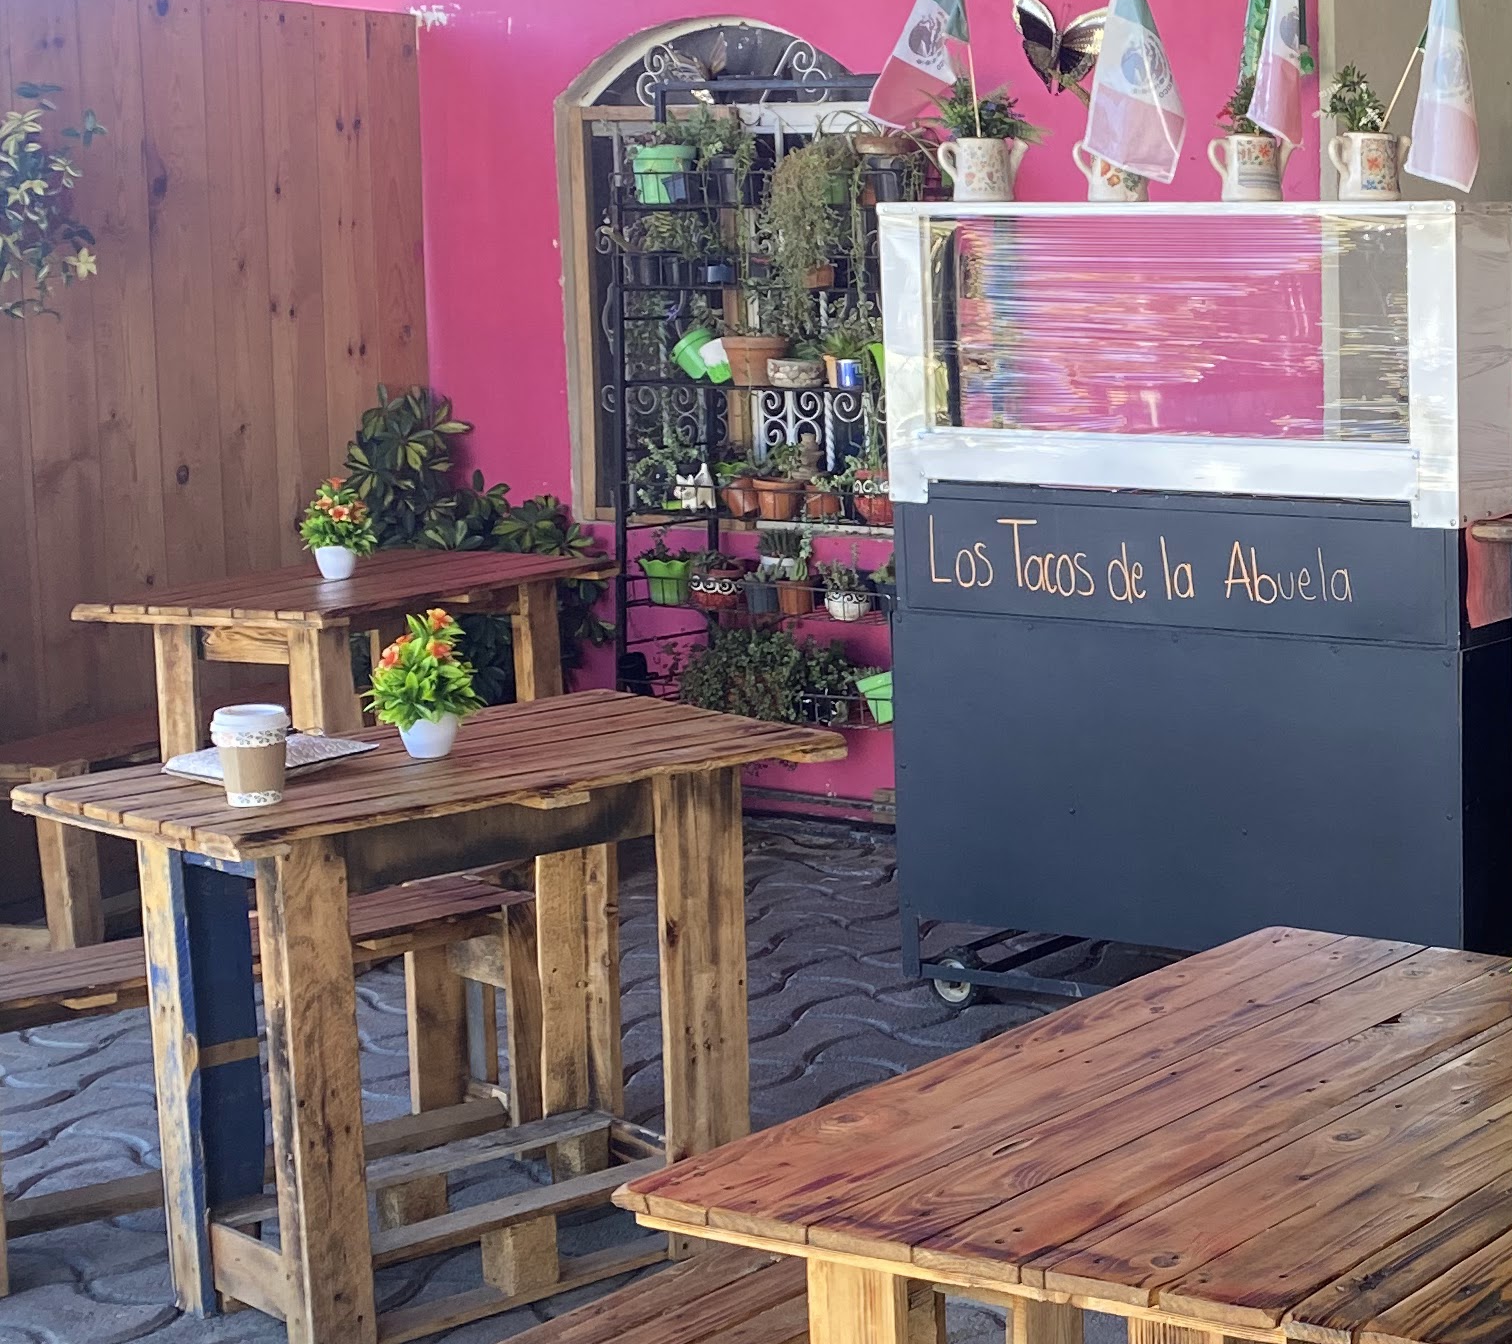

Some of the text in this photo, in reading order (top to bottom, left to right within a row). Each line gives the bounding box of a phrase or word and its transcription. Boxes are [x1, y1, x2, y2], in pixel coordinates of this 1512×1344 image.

[929, 514, 1353, 605] Los Tacos de la Abuela
